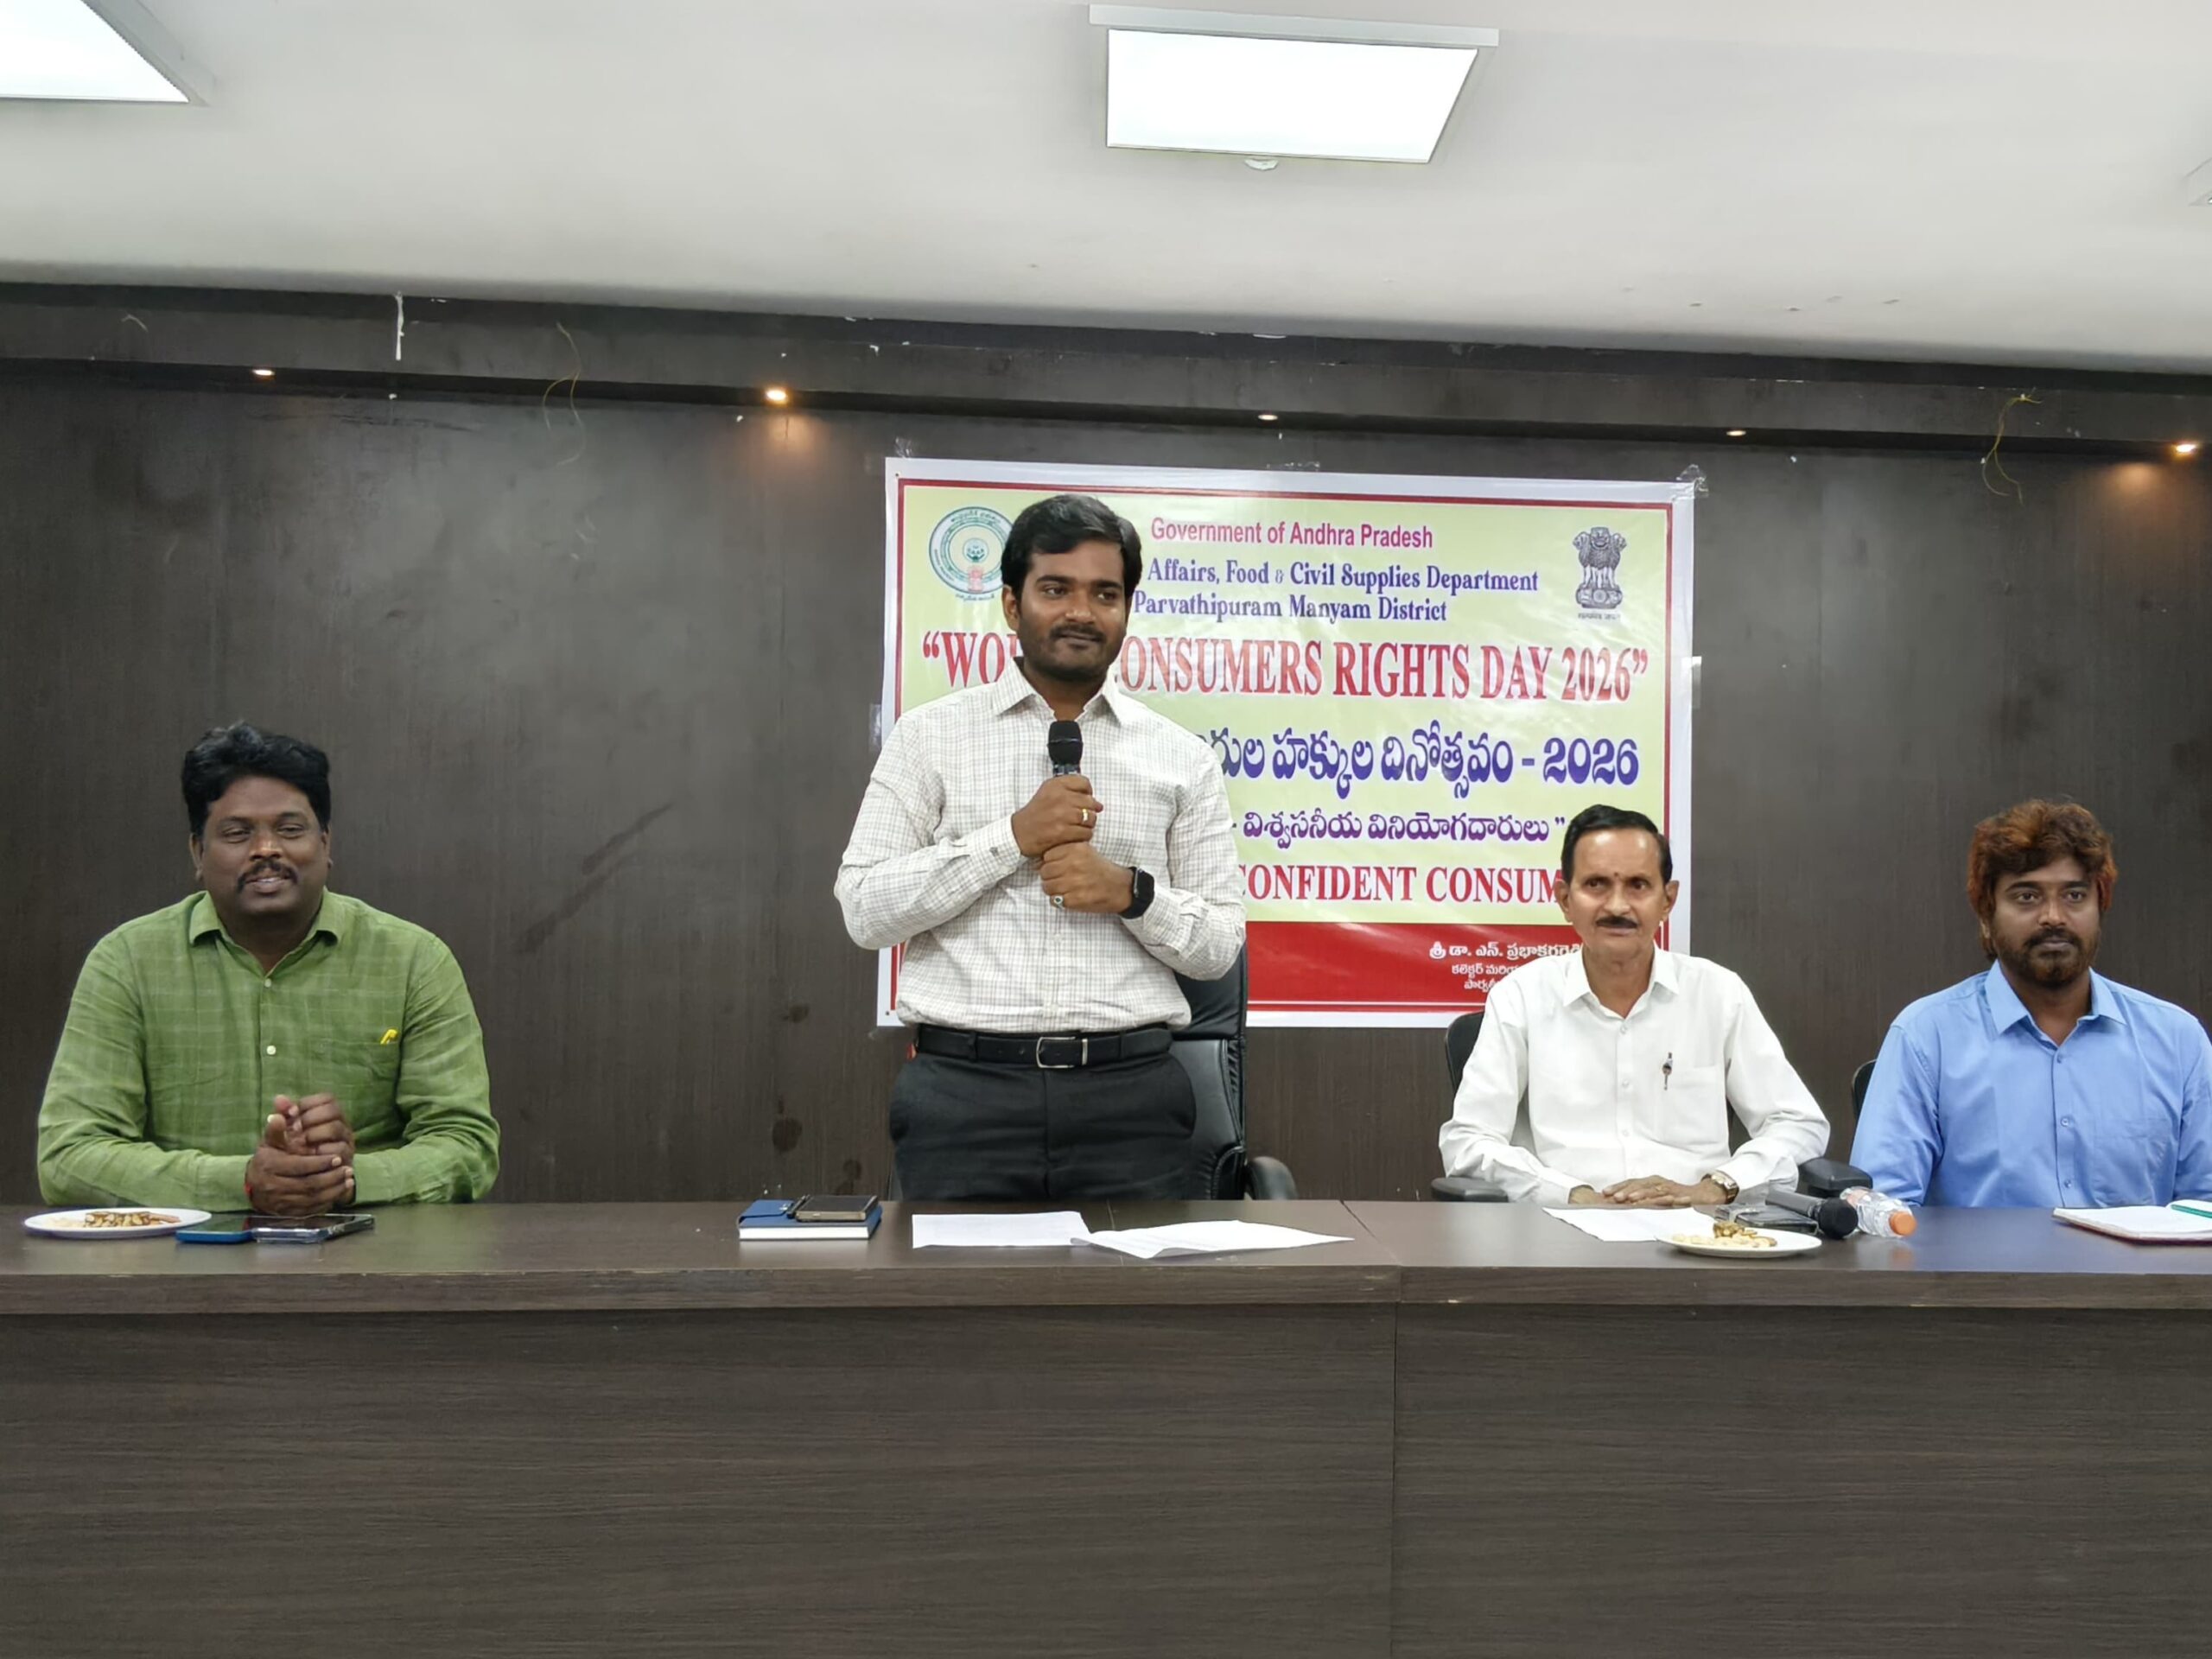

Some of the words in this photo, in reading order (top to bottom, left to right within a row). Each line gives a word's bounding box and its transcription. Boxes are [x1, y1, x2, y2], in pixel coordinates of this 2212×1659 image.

[1151, 517, 1262, 543] Government
[1267, 521, 1286, 544] of
[1290, 522, 1355, 546] Andhra
[1361, 524, 1433, 548] Pradesh
[1147, 557, 1220, 585] Affairs,
[1226, 560, 1269, 584] Food
[1274, 569, 1285, 584] &
[1290, 562, 1335, 586] Civil
[1341, 563, 1421, 594] Supplies
[1427, 565, 1538, 596] Department
[1134, 589, 1282, 623] Parvathipuram
[1289, 594, 1371, 624] Manyam
[1378, 596, 1447, 621] District
[1115, 636, 1322, 696] ONSUMERS
[1332, 641, 1469, 699] RIGHTS
[1479, 645, 1553, 699] DAY
[1273, 728, 1374, 800] హక్కుల
[1381, 720, 1513, 798] దినోత్సవం
[1543, 737, 1639, 785] 2026
[1243, 807, 1363, 849] విశ్వసనీయ
[1427, 867, 1562, 903] CONSUM
